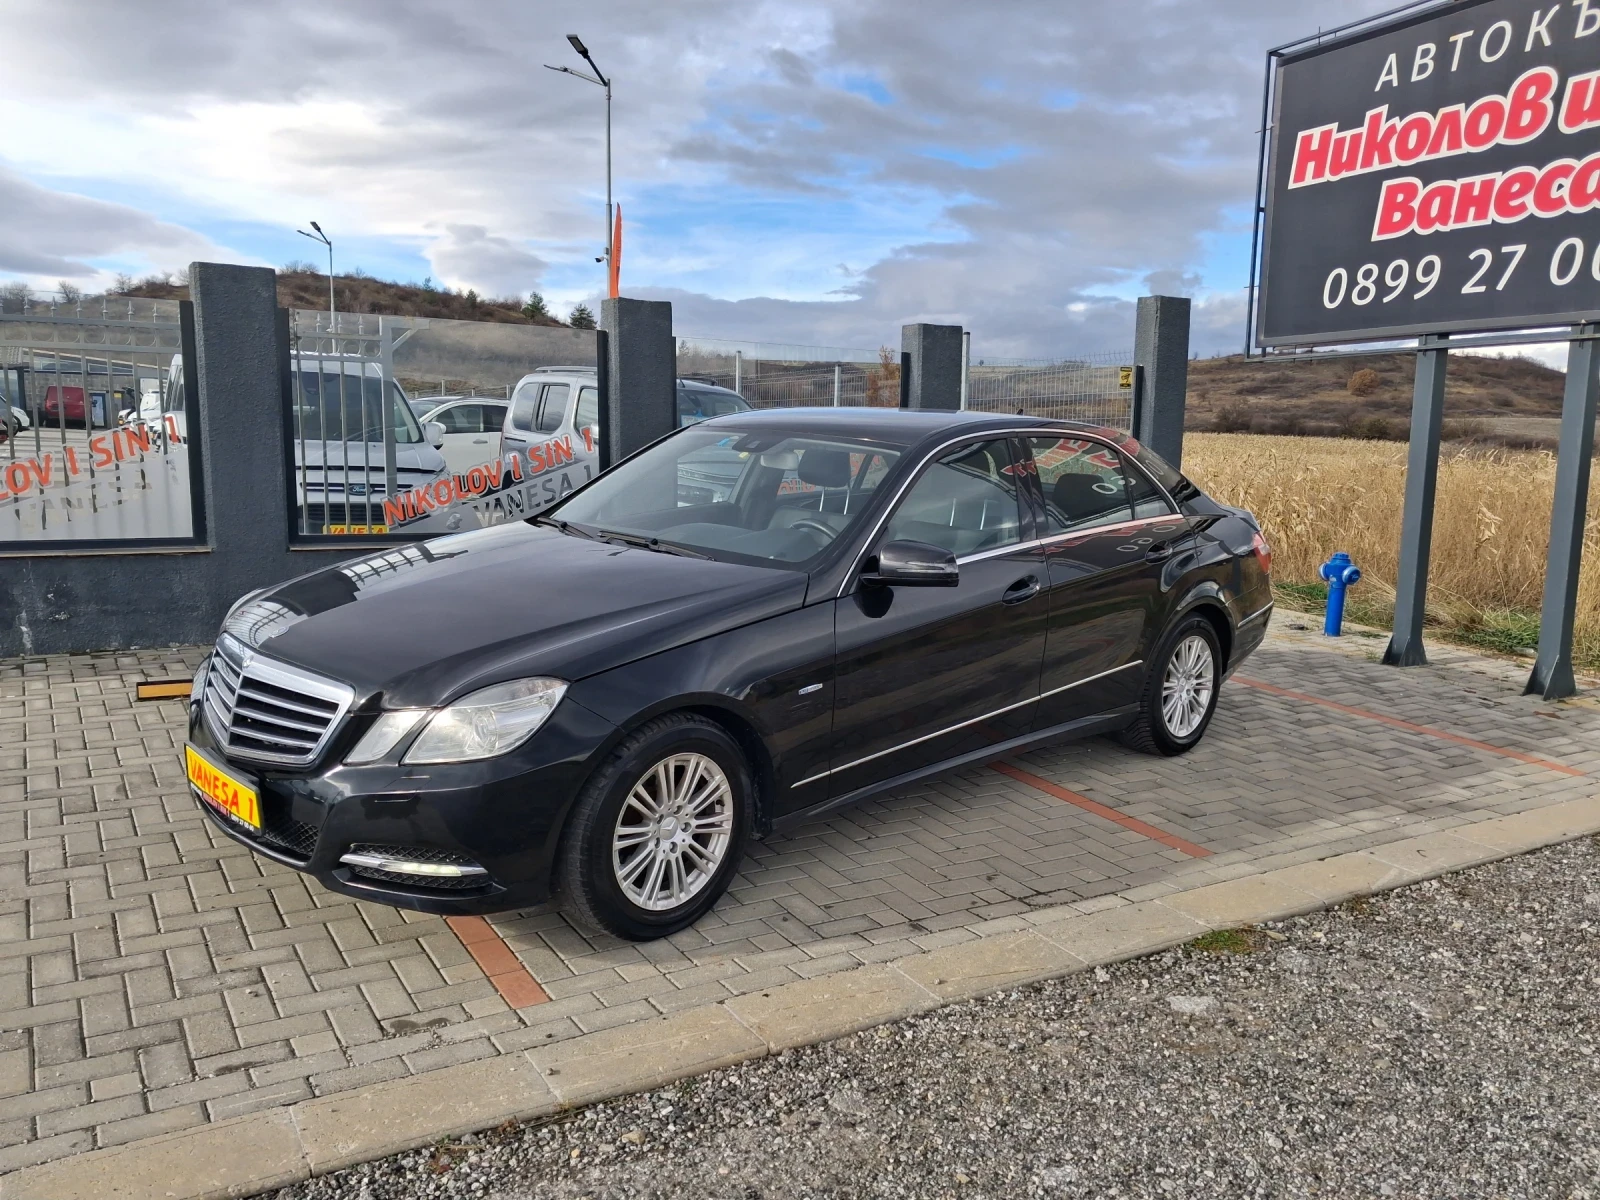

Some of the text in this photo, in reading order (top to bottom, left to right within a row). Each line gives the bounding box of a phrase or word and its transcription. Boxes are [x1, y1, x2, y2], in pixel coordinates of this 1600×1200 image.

[1288, 66, 1558, 189] Николов
[1322, 236, 1600, 310] 0899 27 0
[90, 422, 150, 468] SIN
[383, 459, 502, 527] NIKOLOV
[528, 435, 574, 474] SIN
[472, 472, 574, 528] VANESA
[189, 755, 240, 813] VANESA
[248, 797, 254, 823] 1
